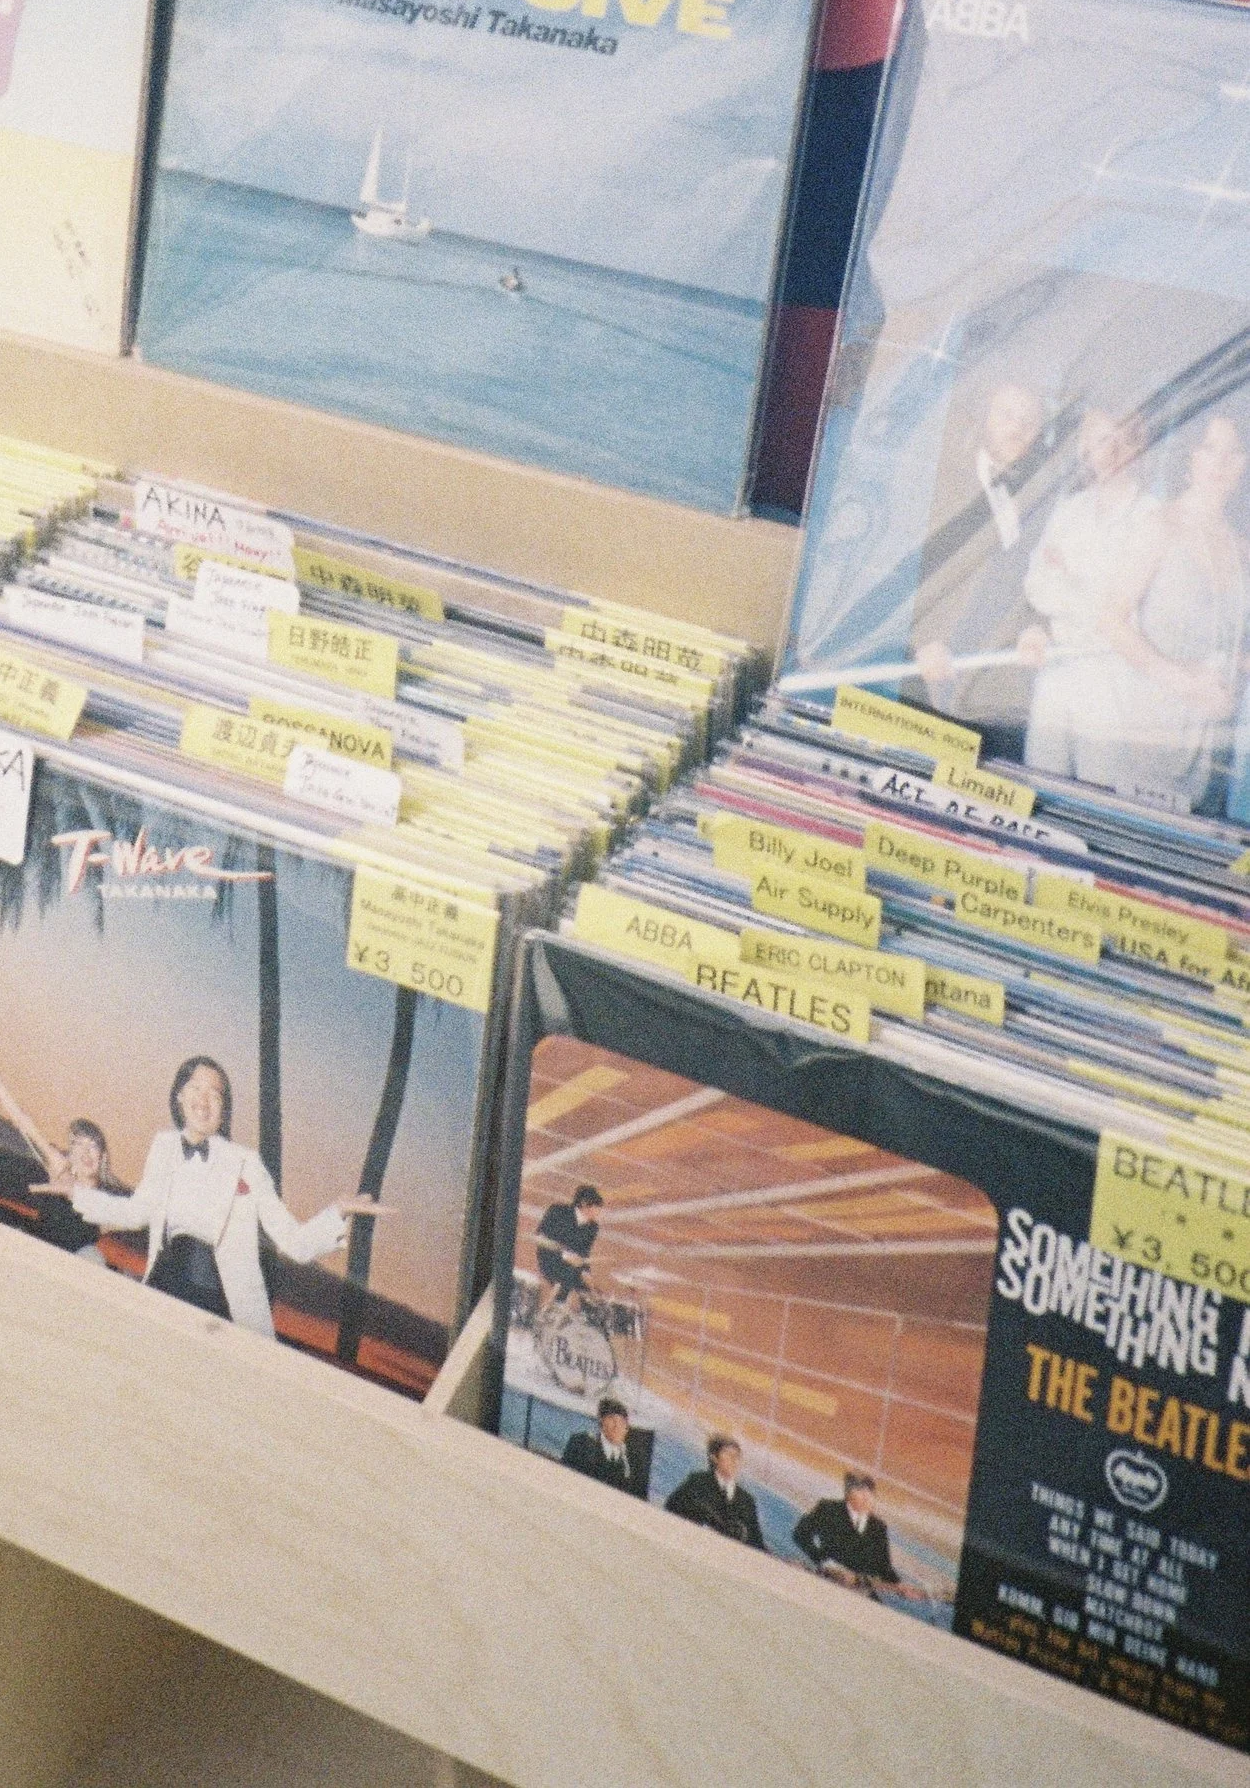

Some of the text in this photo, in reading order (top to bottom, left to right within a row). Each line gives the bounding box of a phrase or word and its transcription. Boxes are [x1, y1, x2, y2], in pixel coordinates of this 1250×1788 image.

[487, 8, 619, 59] Takanaka
[141, 485, 227, 531] AKINA
[839, 696, 935, 740] INTERNATIONAL
[947, 766, 1016, 807] Limahl
[748, 830, 853, 878] Billy Joel
[878, 835, 1020, 900] Deep Purple
[756, 875, 875, 929] Air Supply
[960, 890, 1095, 949] Carpenters
[1067, 889, 1190, 946] Elvis Presley
[624, 914, 693, 952] ABBA
[1120, 935, 1168, 964] USA
[755, 941, 907, 989] ERIC CLAPTON
[695, 963, 852, 1035] BEATLES
[924, 976, 991, 1011] ntana
[1025, 1341, 1100, 1424] THE
